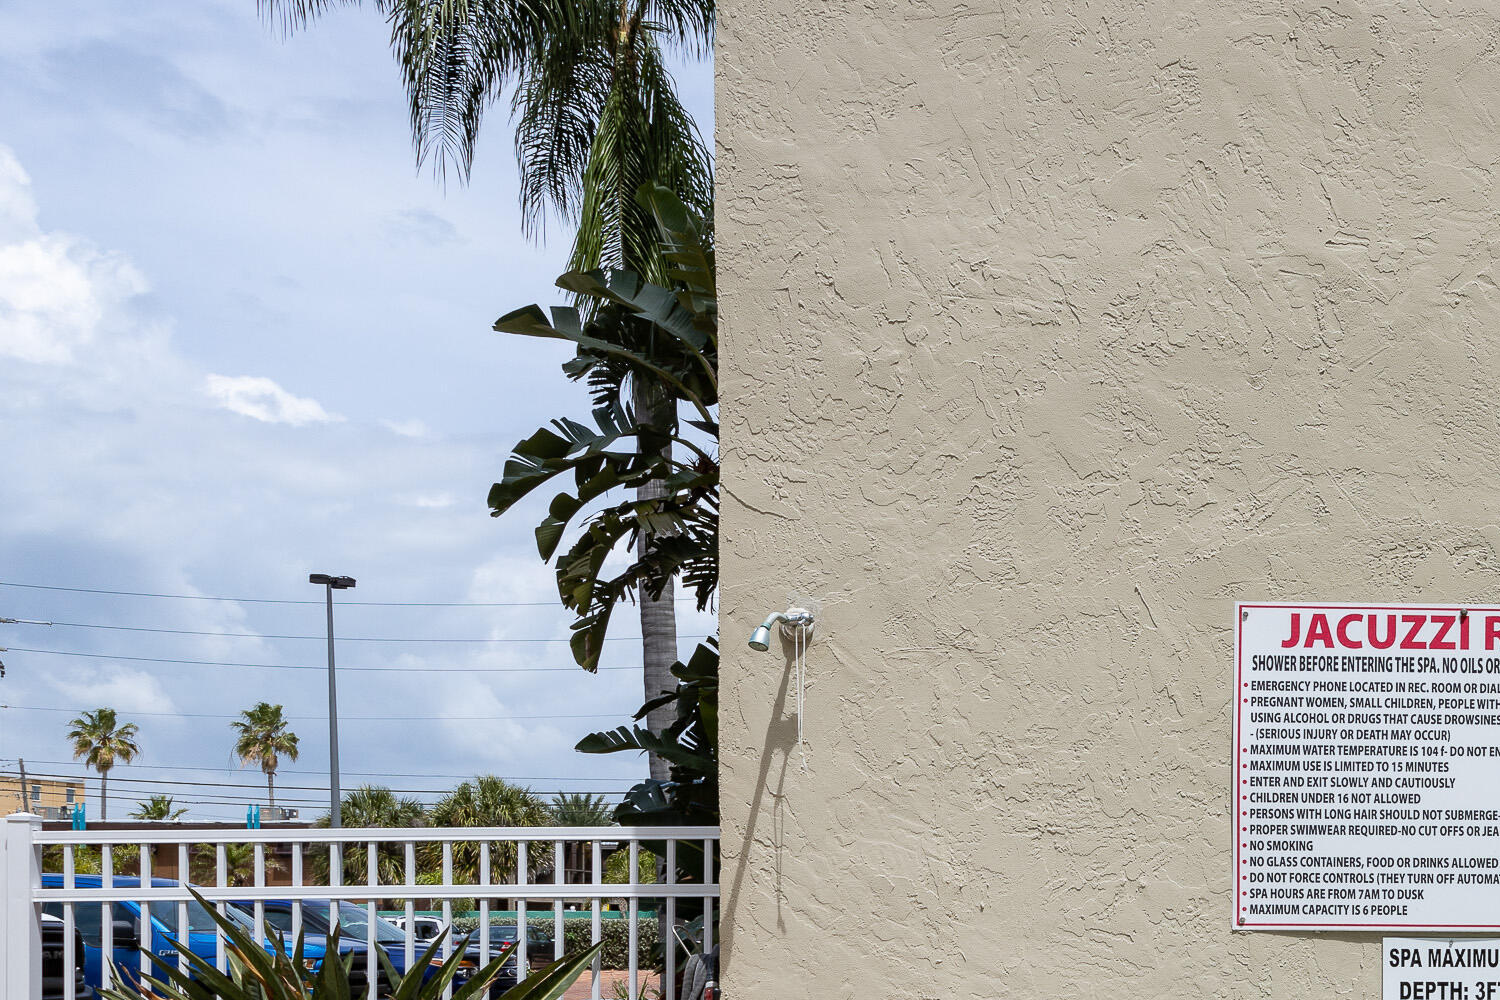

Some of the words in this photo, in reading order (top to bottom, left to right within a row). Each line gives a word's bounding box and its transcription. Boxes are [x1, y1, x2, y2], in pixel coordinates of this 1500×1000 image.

[1281, 613, 1469, 650] JACUZZI
[1252, 655, 1297, 672] SHOWER
[1299, 656, 1339, 673] BEFORE
[1341, 656, 1393, 673] ENTERING
[1394, 657, 1415, 674] THE
[1417, 657, 1440, 674] SPA.
[1442, 657, 1458, 674] NO
[1459, 657, 1483, 674] OILS
[1485, 658, 1500, 675] OR
[1250, 681, 1311, 692] EMERGENCY
[1312, 682, 1347, 693] PHONE
[1349, 682, 1393, 693] LOCATED
[1395, 682, 1406, 693] IN
[1407, 683, 1429, 694] REC.
[1431, 683, 1461, 694] ROOM
[1463, 683, 1477, 694] OR
[1250, 697, 1304, 708] PREGNANT
[1305, 697, 1347, 710] WOMEN,
[1349, 698, 1382, 709] SMALL
[1384, 698, 1436, 711] CHILDREN,
[1438, 699, 1475, 710] PEOPLE
[1250, 713, 1281, 724] USING
[1283, 713, 1329, 724] ALCOHOL
[1331, 714, 1345, 725] OR
[1347, 714, 1381, 725] DRUGS
[1382, 714, 1408, 725] THAT
[1410, 714, 1442, 725] CAUSE
[1255, 729, 1301, 741] (SERIOUS
[1303, 729, 1338, 740] INJURY
[1339, 729, 1354, 740] OR
[1356, 730, 1388, 741] DEATH
[1390, 730, 1412, 741] MAY
[1413, 730, 1450, 743] OCCUR)
[1250, 745, 1300, 756] MAXIMUM
[1302, 745, 1335, 756] WATER
[1336, 746, 1408, 757] TEMPERATURE
[1409, 746, 1418, 757] IS
[1421, 746, 1439, 757] 104
[1449, 746, 1465, 757] DO
[1466, 746, 1487, 757] NOT
[1249, 761, 1300, 772] MAXIMUM
[1302, 761, 1321, 772] USE
[1323, 761, 1332, 772] IS
[1334, 761, 1374, 772] LIMITED
[1376, 761, 1389, 772] TO
[1391, 761, 1404, 772] 15
[1405, 761, 1449, 772] MINUTES
[1249, 777, 1281, 788] ENTER
[1282, 777, 1304, 788] AND
[1306, 777, 1328, 788] EXIT
[1330, 777, 1369, 788] SLOWLY
[1370, 777, 1393, 788] AND
[1394, 777, 1455, 788] CAUTIOUSLY
[1249, 793, 1298, 804] CHILDREN
[1300, 793, 1335, 804] UNDER
[1337, 793, 1349, 804] 16
[1351, 793, 1372, 804] NOT
[1373, 793, 1421, 804] ALLOWED
[1249, 809, 1294, 820] PERSONS
[1295, 809, 1322, 820] WITH
[1324, 809, 1351, 820] LONG
[1353, 809, 1377, 820] HAIR
[1379, 810, 1420, 821] SHOULD
[1422, 810, 1443, 821] NOT
[1249, 825, 1288, 836] PROPER
[1290, 825, 1346, 836] SWIMWEAR
[1418, 826, 1438, 837] CUT
[1439, 826, 1464, 837] OFFS
[1466, 826, 1480, 837] OR
[1249, 841, 1264, 852] NO
[1266, 841, 1313, 852] SMOKING
[1249, 857, 1264, 868] NO
[1266, 857, 1298, 868] GLASS
[1299, 857, 1364, 870] CONTAINERS,
[1366, 858, 1394, 869] FOOD
[1396, 858, 1410, 869] OR
[1412, 858, 1449, 869] DRINKS
[1451, 858, 1498, 869] ALLOWED
[1249, 873, 1264, 884] DO
[1266, 873, 1287, 884] NOT
[1289, 873, 1320, 884] FORCE
[1322, 873, 1374, 884] CONTROLS
[1376, 874, 1405, 887] (THEY
[1406, 874, 1434, 885] TURN
[1435, 874, 1455, 885] OFF
[1249, 889, 1268, 900] SPA
[1270, 889, 1304, 900] HOURS
[1306, 889, 1325, 900] ARE
[1327, 889, 1356, 900] FROM
[1358, 889, 1380, 900] 7AM
[1381, 889, 1395, 900] TO
[1397, 889, 1424, 900] DUSK
[1249, 905, 1299, 916] MAXIMUM
[1301, 905, 1349, 916] CAPACITY
[1351, 905, 1360, 916] IS
[1362, 905, 1368, 916] 6
[1370, 905, 1407, 916] PEOPLE
[1388, 949, 1422, 968] SPA
[1399, 981, 1468, 1000] DEPTH:
